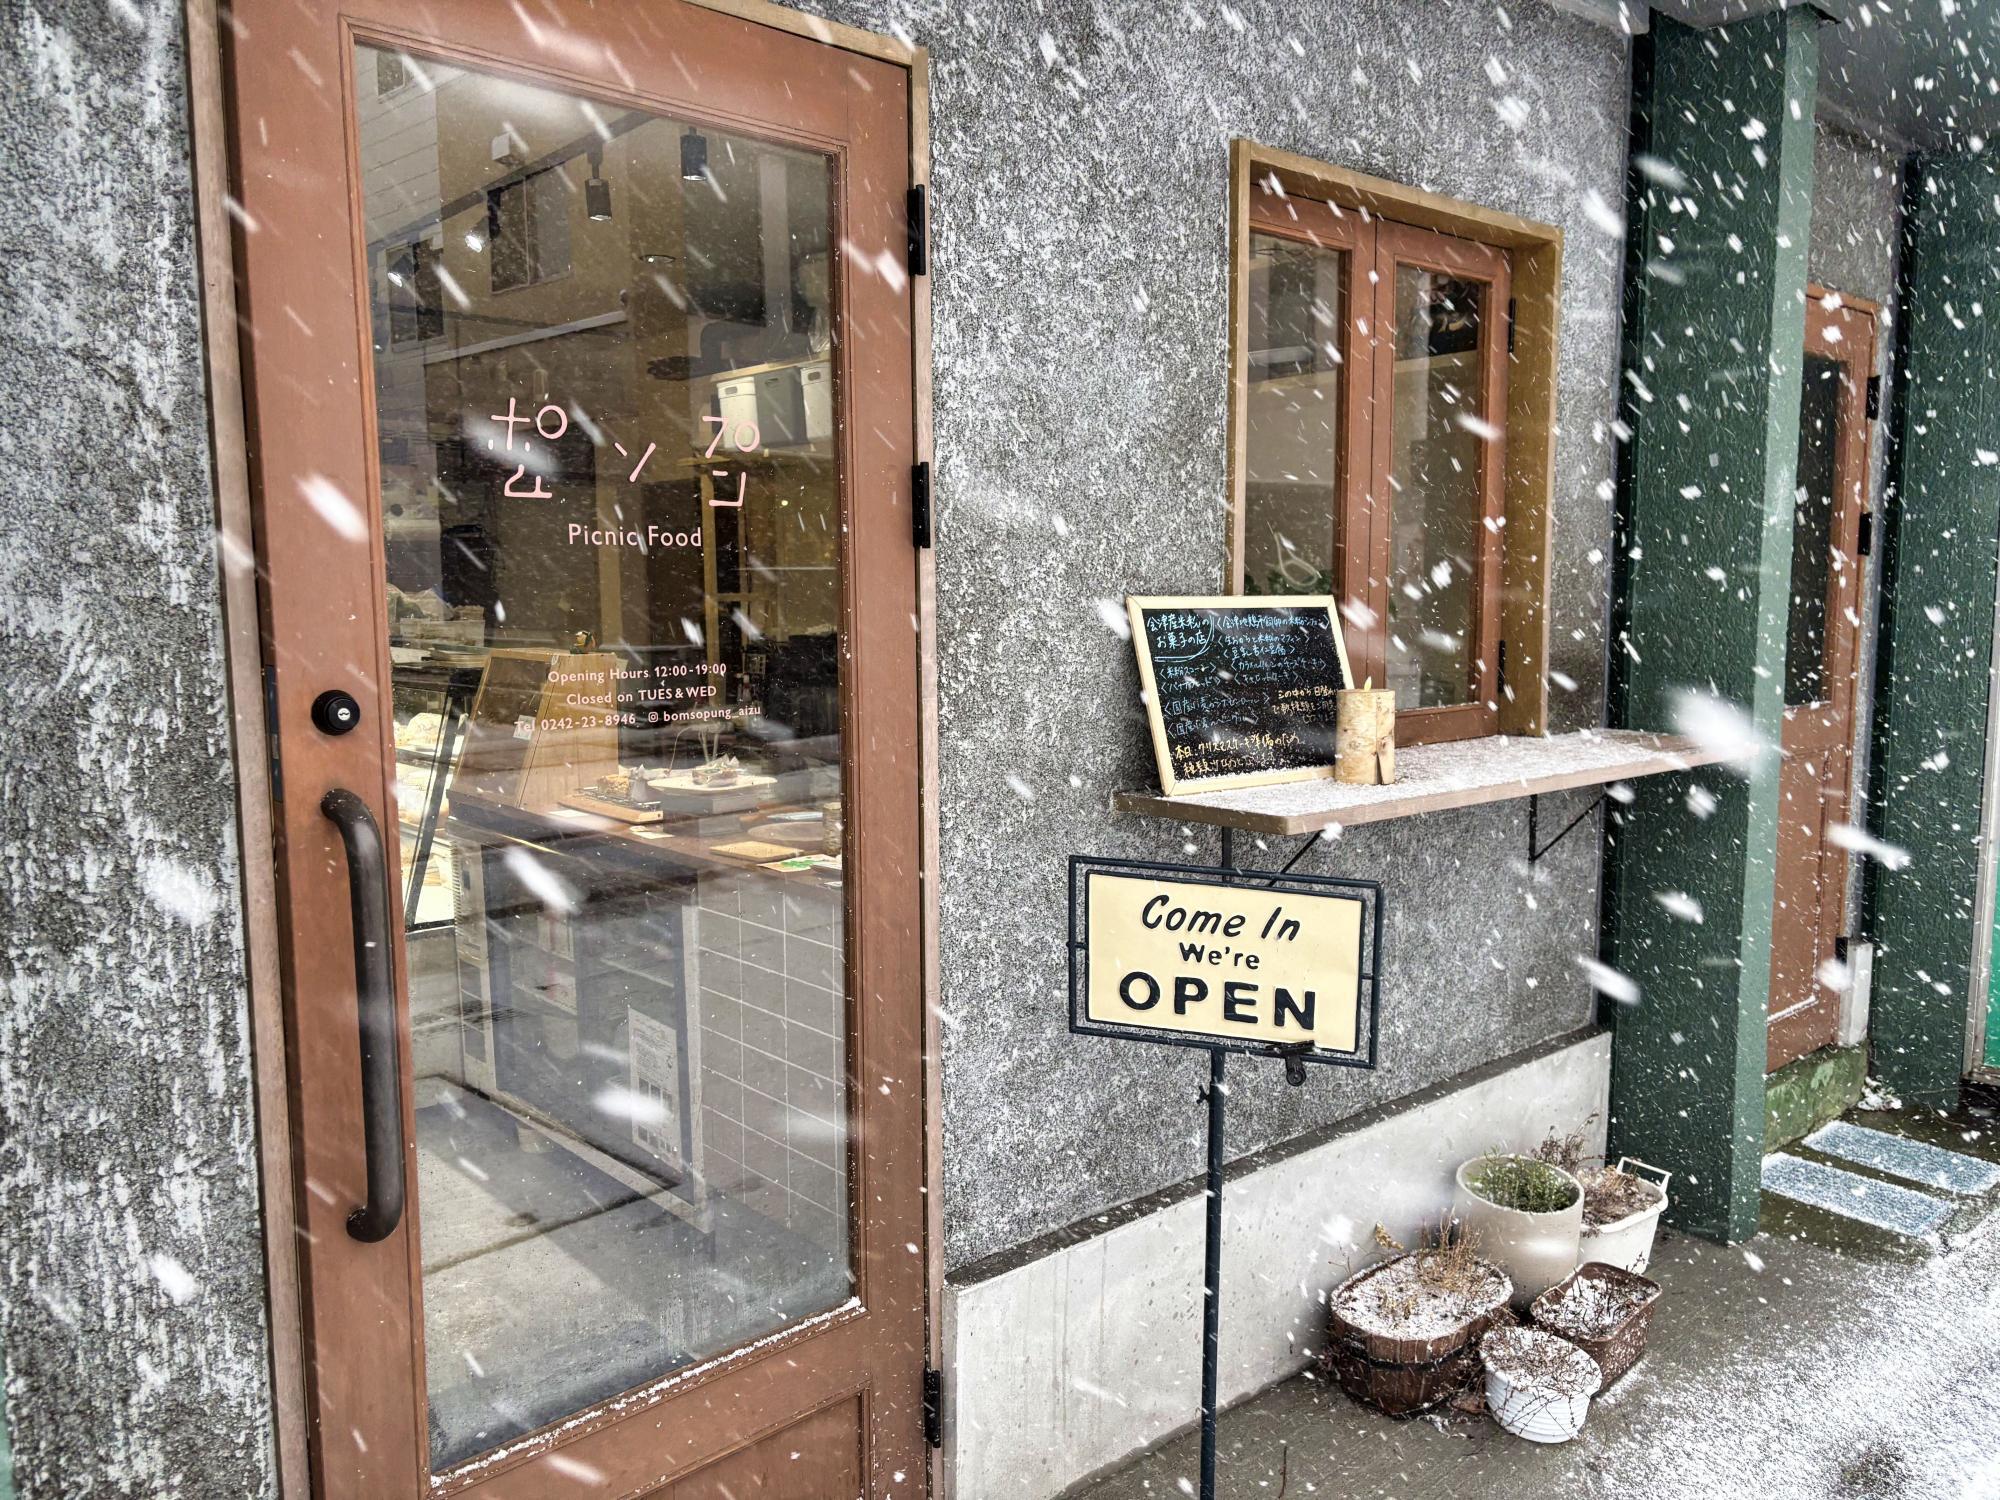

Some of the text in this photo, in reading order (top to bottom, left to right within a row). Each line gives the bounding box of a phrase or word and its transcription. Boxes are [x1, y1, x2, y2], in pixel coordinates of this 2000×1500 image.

[568, 523, 702, 547] Picnic Food
[1157, 630, 1206, 649] お菓子の店
[547, 663, 727, 686] Opening Hours 12:00-19:00
[566, 693, 612, 706] Closed
[617, 694, 633, 702] on
[514, 705, 761, 733] Tel 0242-23-8946 bomsopung_aizu
[1142, 894, 1301, 942] Come In
[1179, 942, 1261, 970] We're
[1119, 971, 1317, 1031] OPEN
